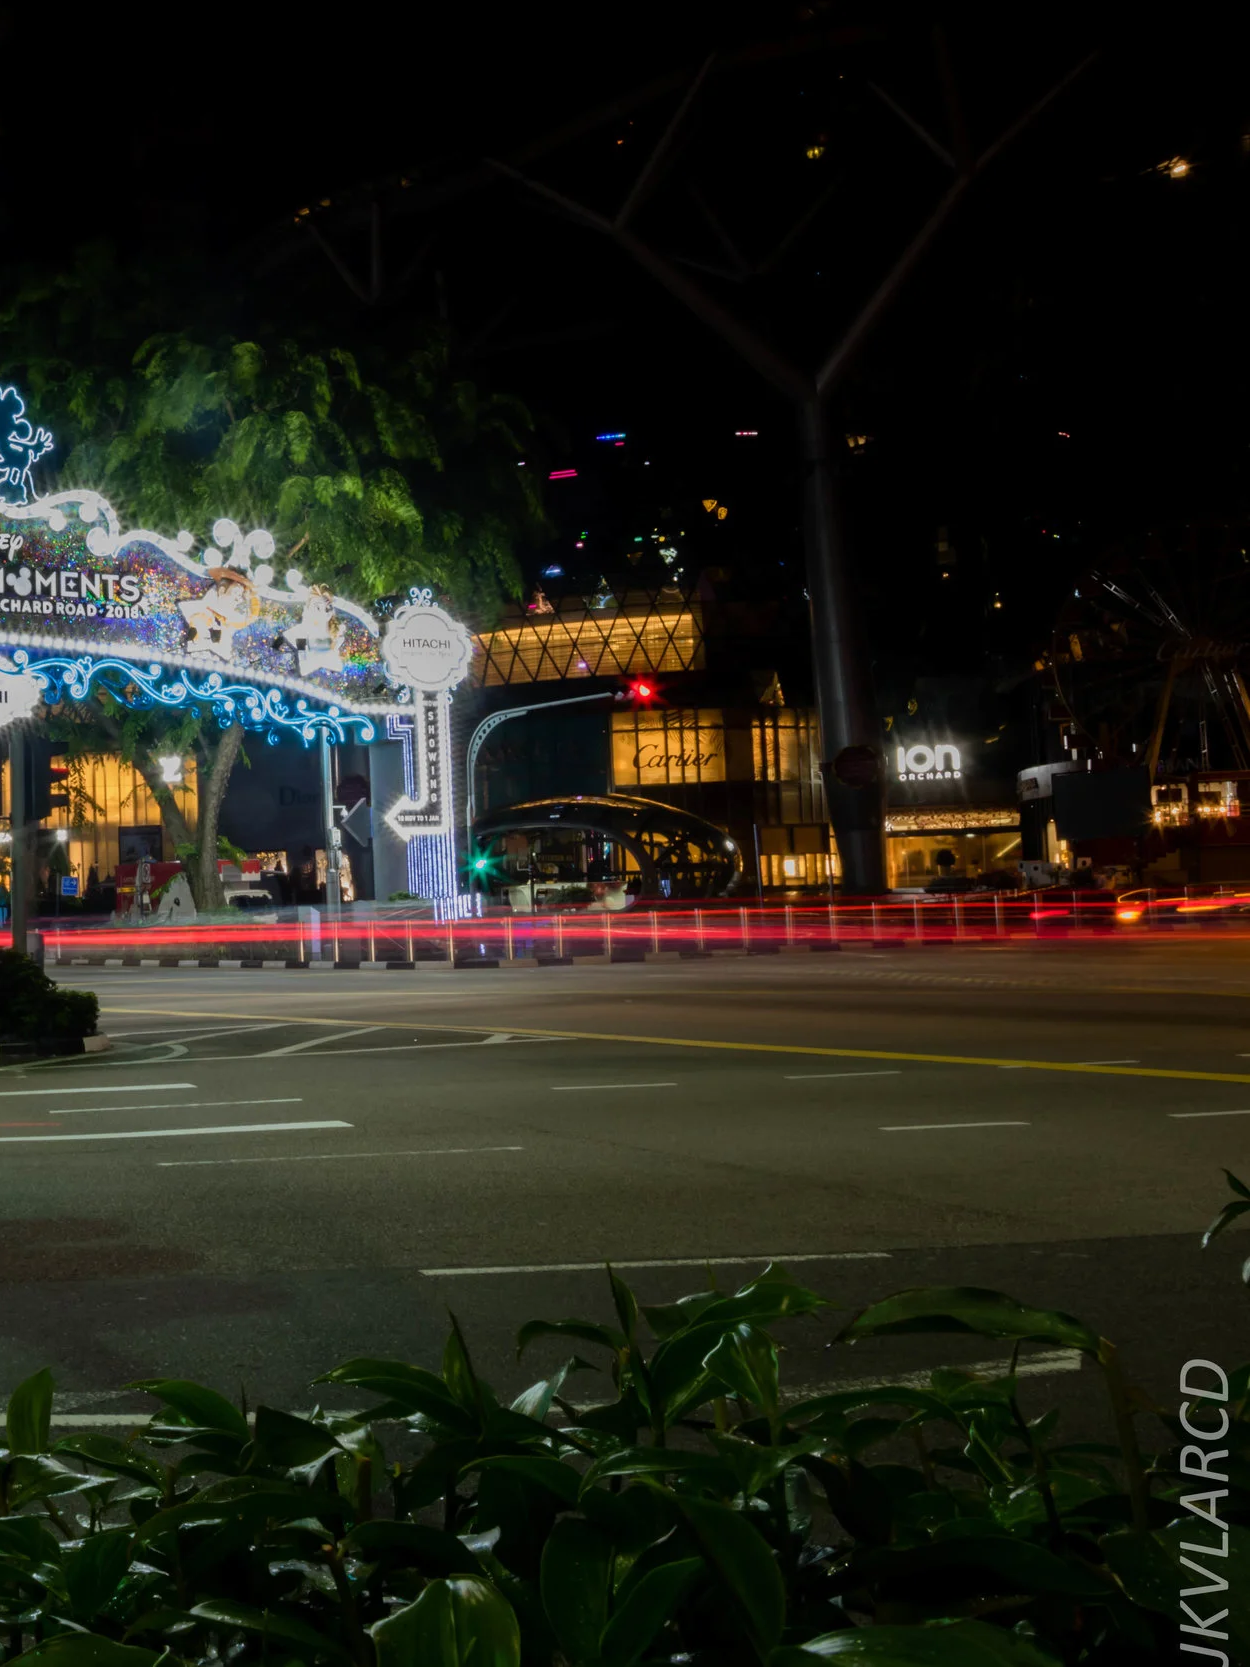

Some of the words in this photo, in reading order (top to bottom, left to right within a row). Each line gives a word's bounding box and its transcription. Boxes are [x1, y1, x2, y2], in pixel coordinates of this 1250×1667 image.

[56, 601, 97, 617] ROAD
[105, 605, 140, 620] 2018
[403, 638, 451, 649] HITACHI
[427, 711, 438, 803] SHOWING
[633, 743, 718, 769] Cartier
[898, 770, 962, 782] ORCHARD
